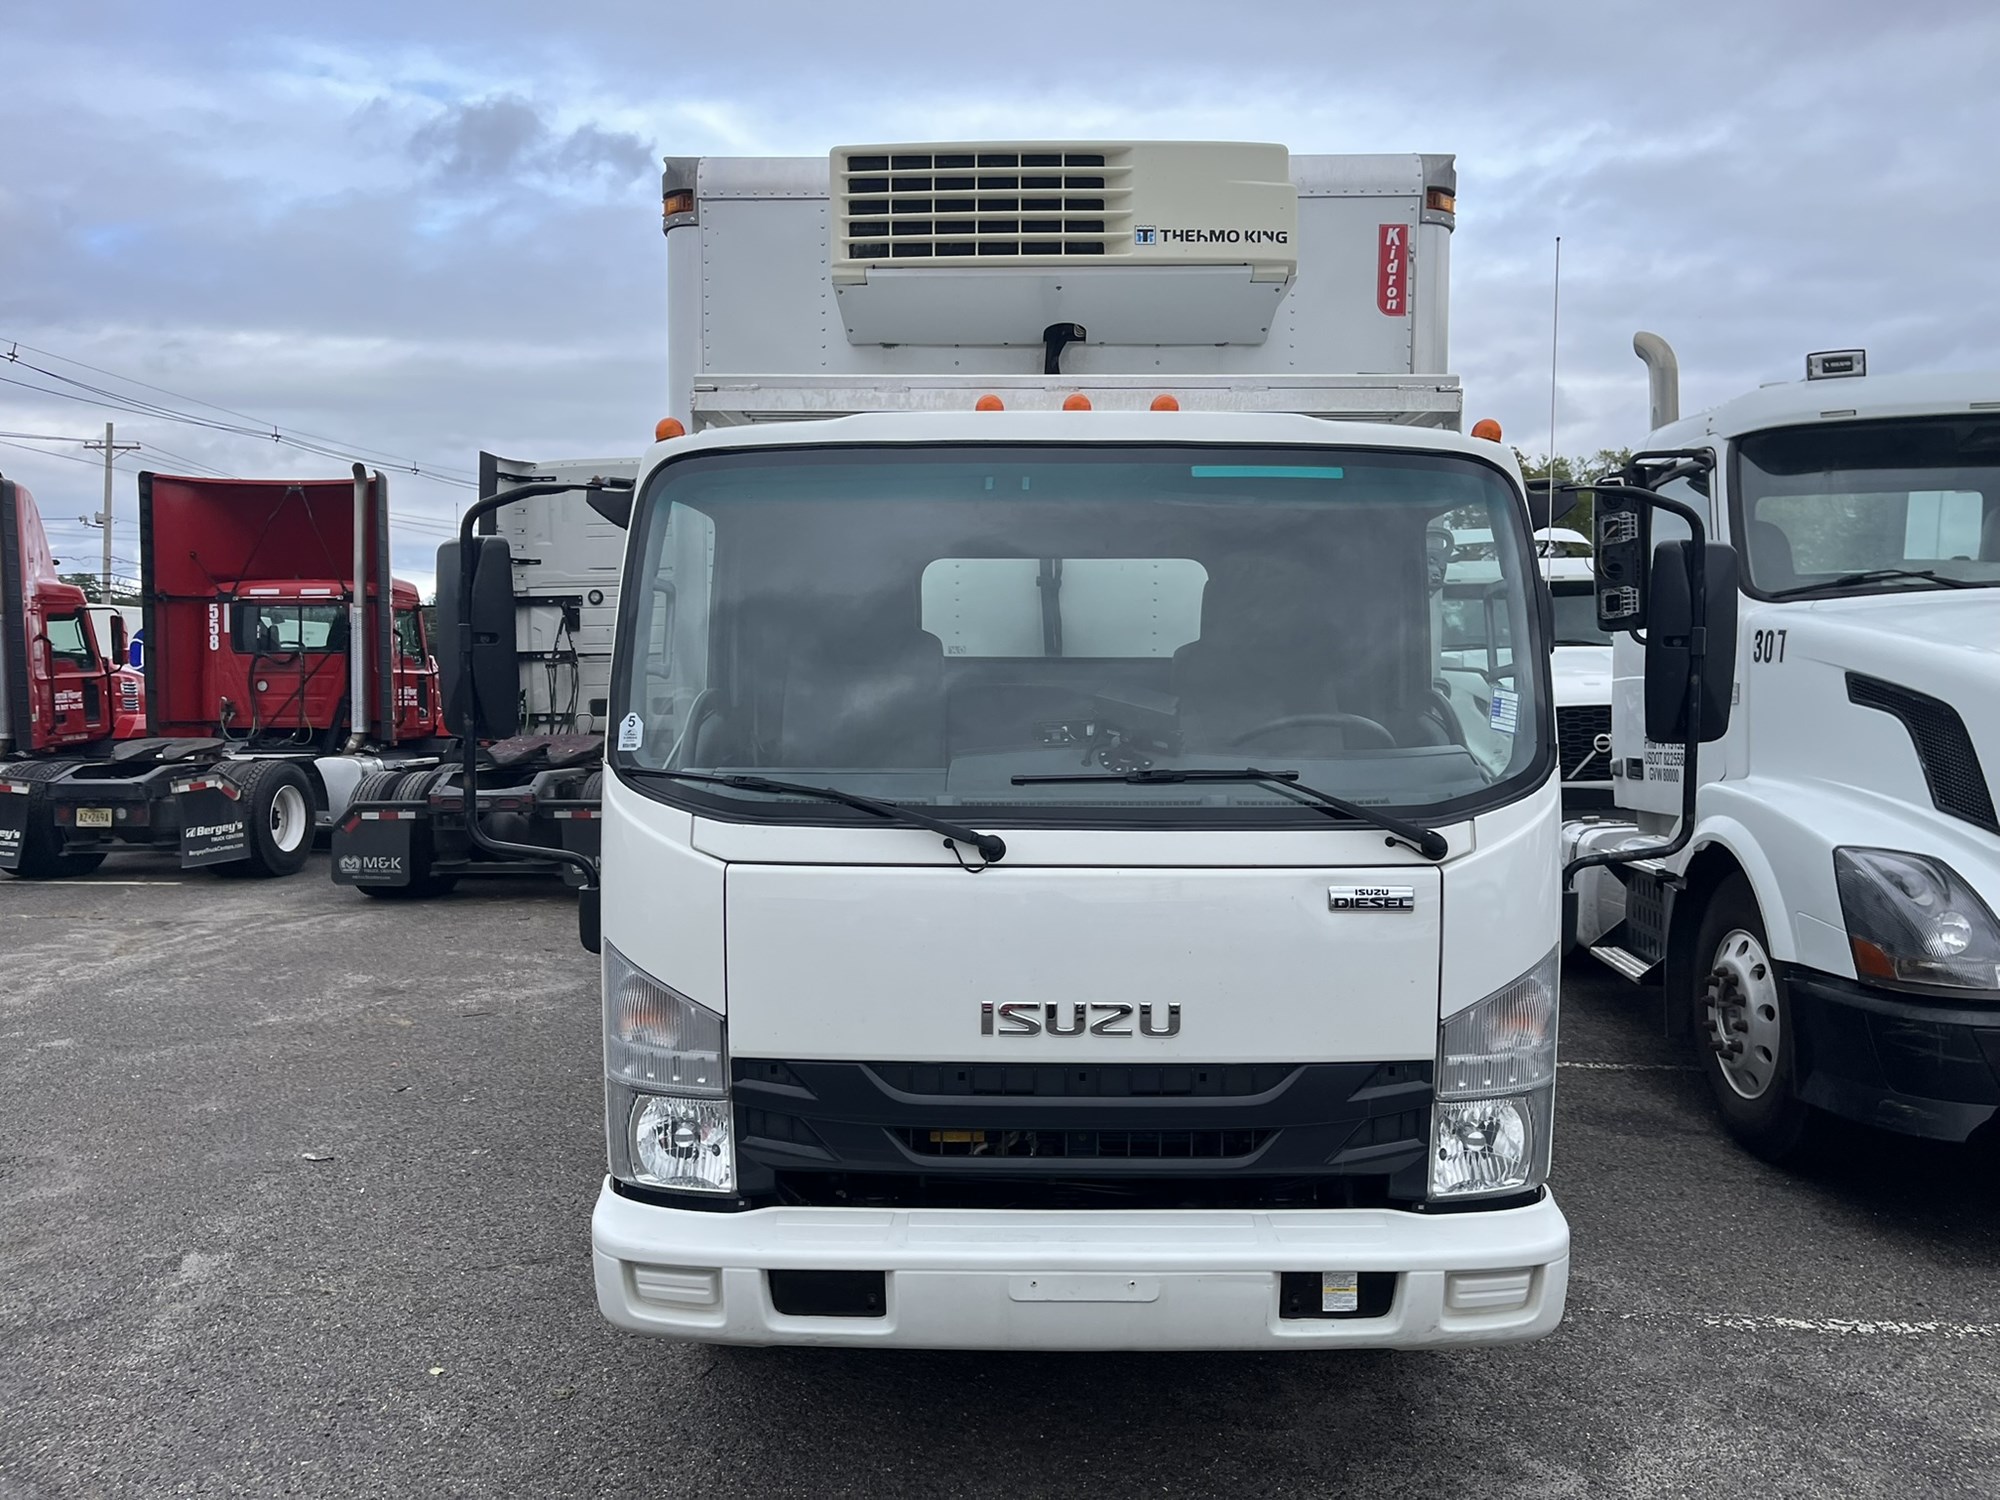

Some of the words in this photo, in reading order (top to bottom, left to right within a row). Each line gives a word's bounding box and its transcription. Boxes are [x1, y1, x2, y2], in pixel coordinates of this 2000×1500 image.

[1245, 230, 1288, 244] KING
[1386, 227, 1401, 310] Kidron
[209, 603, 219, 650] 558
[1753, 629, 1787, 663] 307
[628, 715, 636, 728] 5
[1645, 751, 1662, 765] USDOT
[197, 820, 243, 836] Bergey's
[363, 856, 401, 869] M&K
[1354, 888, 1389, 896] ISUZU
[1333, 897, 1413, 909] DIESEL
[981, 1000, 1181, 1039] ISUZU
